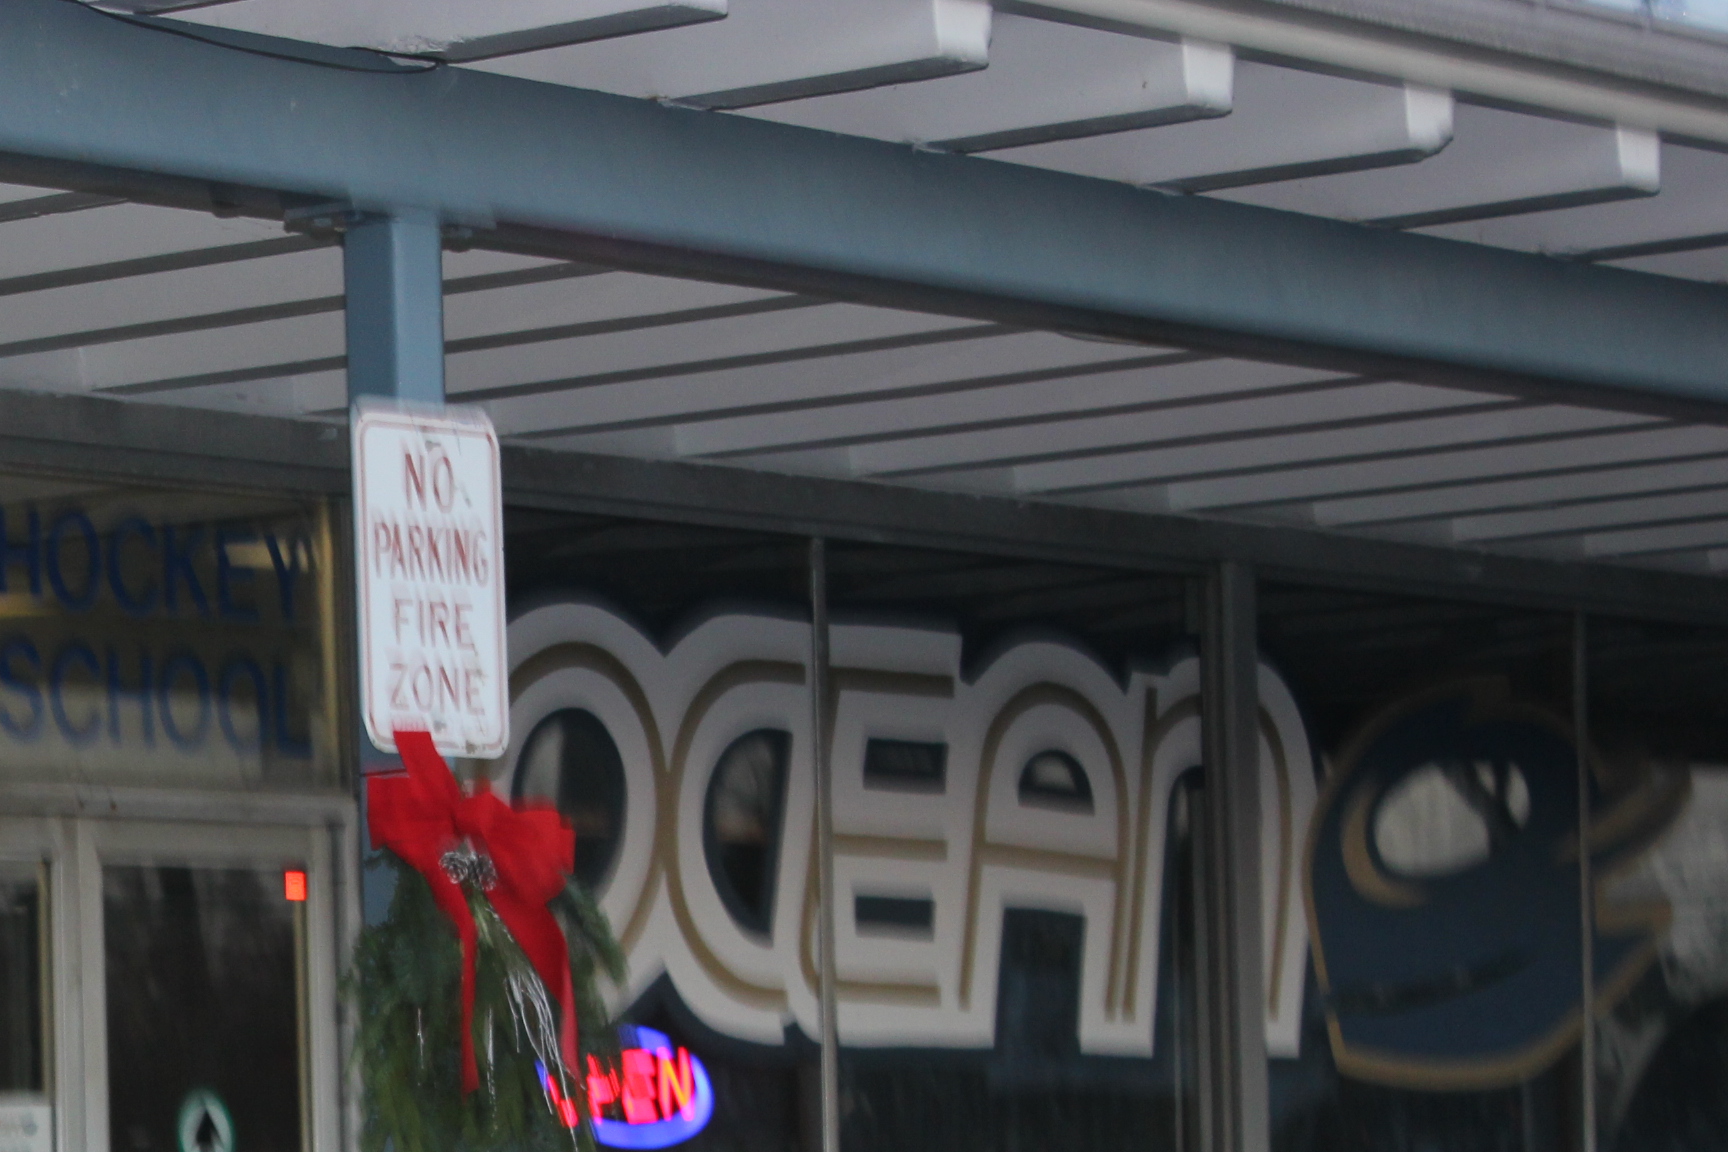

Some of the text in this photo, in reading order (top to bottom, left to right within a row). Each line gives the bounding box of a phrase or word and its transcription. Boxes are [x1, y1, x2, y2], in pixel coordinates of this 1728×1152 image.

[402, 446, 456, 513] NO
[373, 520, 489, 588] PARKING
[393, 597, 474, 651] FIRE
[388, 660, 485, 717] ZONE
